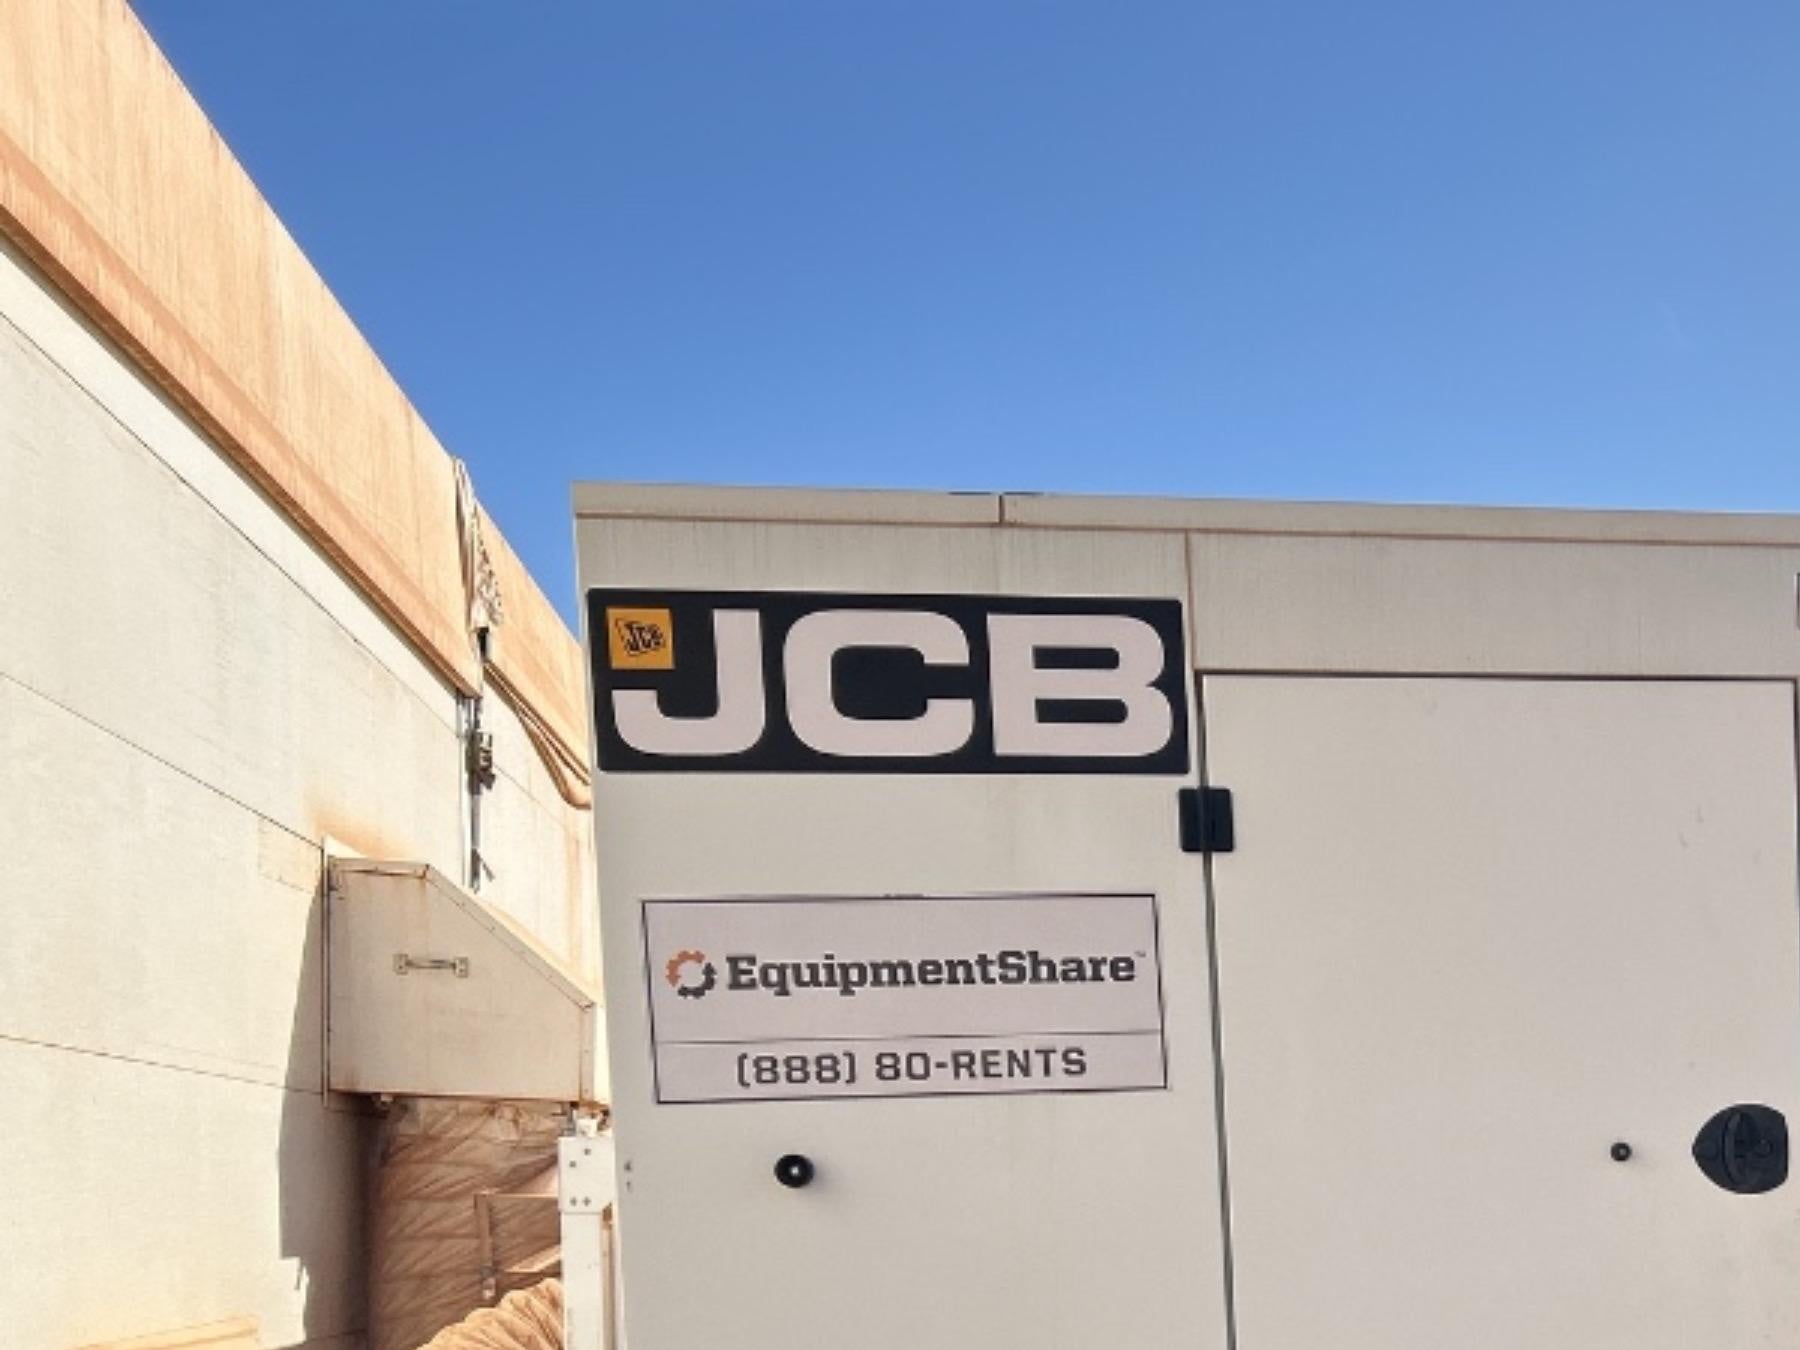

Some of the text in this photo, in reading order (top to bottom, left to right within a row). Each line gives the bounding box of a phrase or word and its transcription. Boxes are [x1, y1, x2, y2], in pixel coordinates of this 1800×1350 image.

[611, 608, 1174, 757] JCB
[726, 950, 1136, 997] EquipmentShare
[737, 1046, 1087, 1088] (888) 80-RENTS
